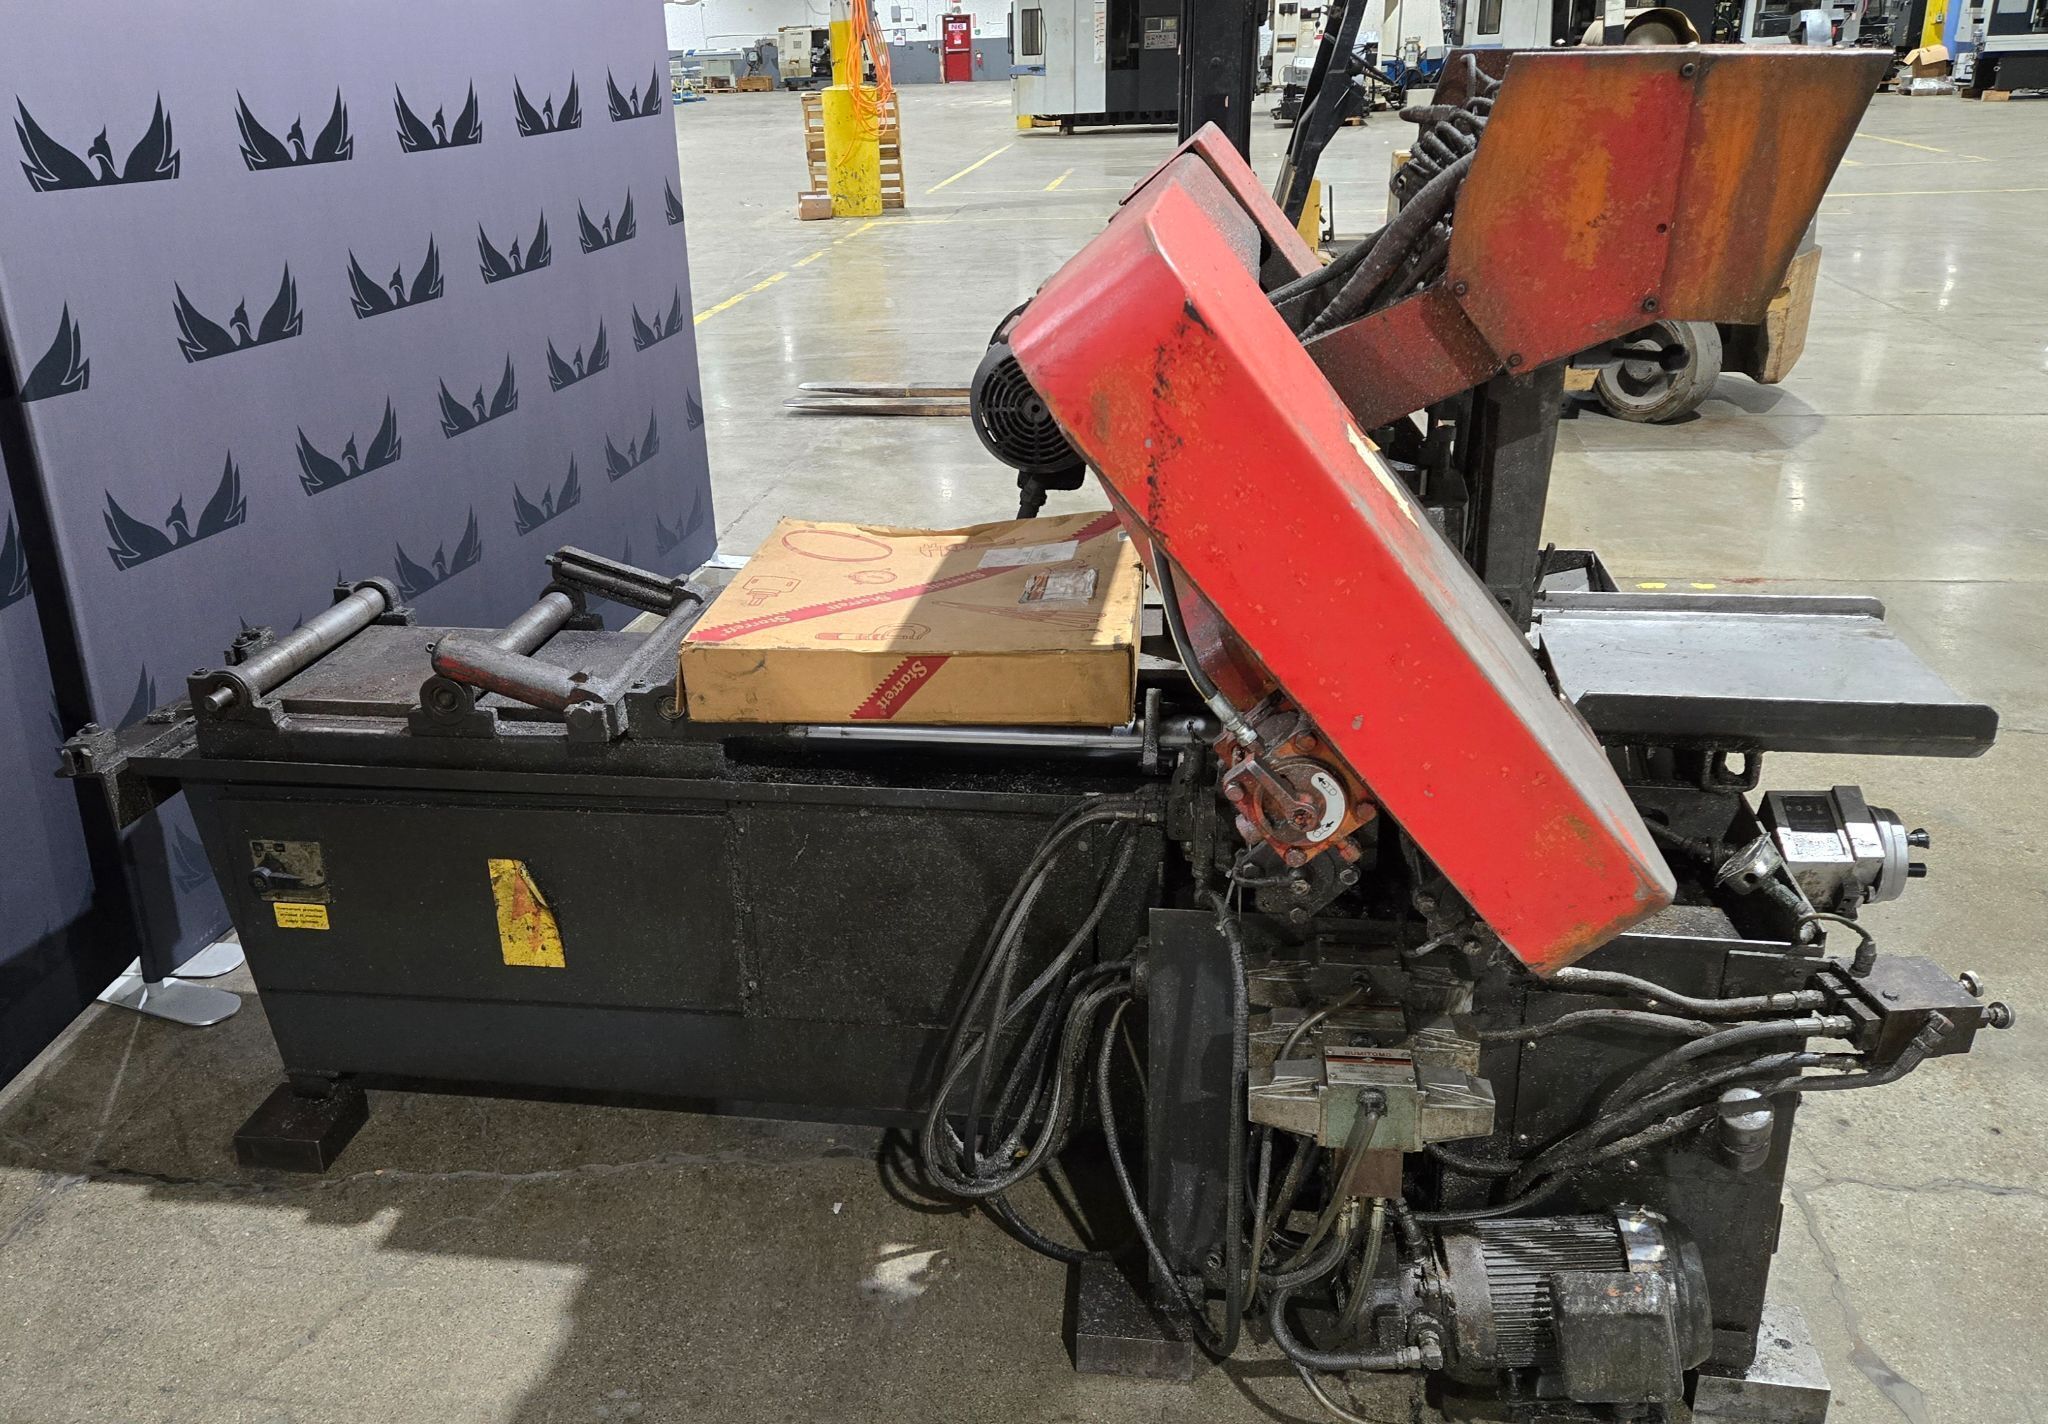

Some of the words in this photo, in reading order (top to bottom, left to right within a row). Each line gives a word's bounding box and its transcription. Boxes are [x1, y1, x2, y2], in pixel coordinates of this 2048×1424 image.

[827, 594, 891, 611] Starrett
[721, 615, 791, 635] Starrett
[876, 660, 928, 711] Starrett
